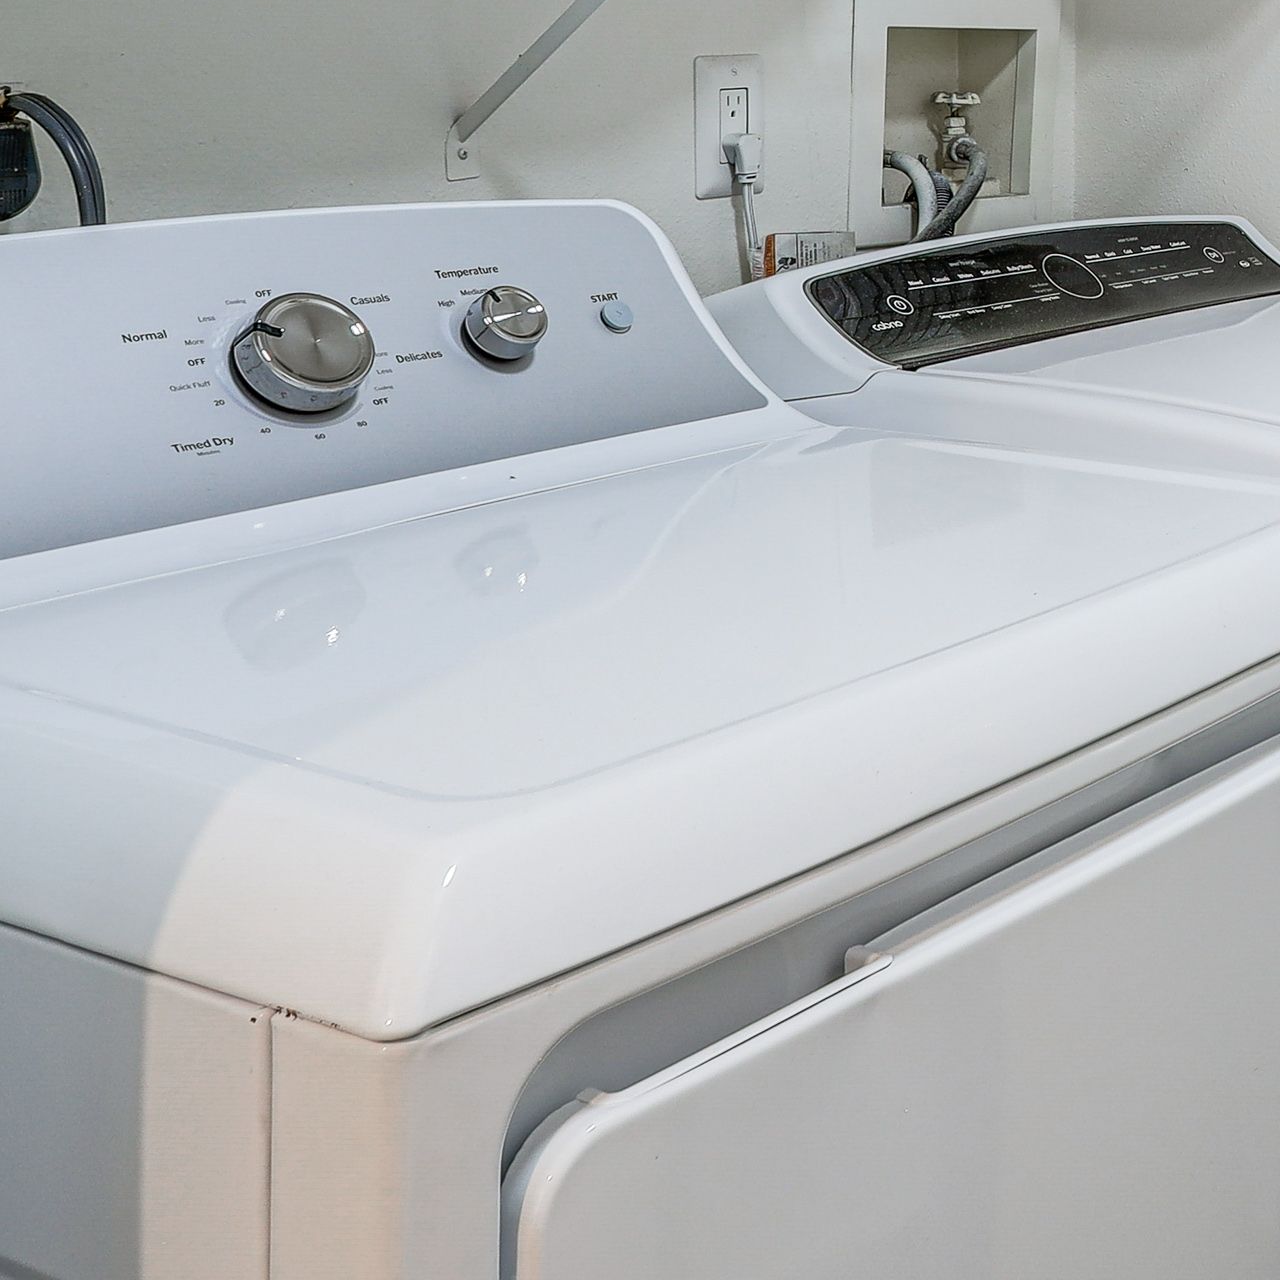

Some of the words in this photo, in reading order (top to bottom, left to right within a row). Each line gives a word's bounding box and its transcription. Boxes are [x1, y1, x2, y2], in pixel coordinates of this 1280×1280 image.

[434, 265, 499, 280] Temperature
[255, 289, 272, 298] OFF
[459, 288, 488, 297] Medium
[590, 292, 620, 303] START
[350, 294, 391, 306] Casuals
[437, 299, 456, 309] High
[197, 315, 216, 323] Less
[121, 329, 168, 344] Normal
[184, 338, 205, 347] More
[395, 349, 443, 364] Delicates
[187, 357, 206, 367] OFF
[376, 367, 393, 375] Less
[169, 383, 192, 393] Quick
[192, 380, 211, 390] Fluff
[213, 399, 226, 407] 20
[372, 397, 389, 406] OFF
[171, 439, 212, 454] Timed
[212, 436, 235, 447] Dry
